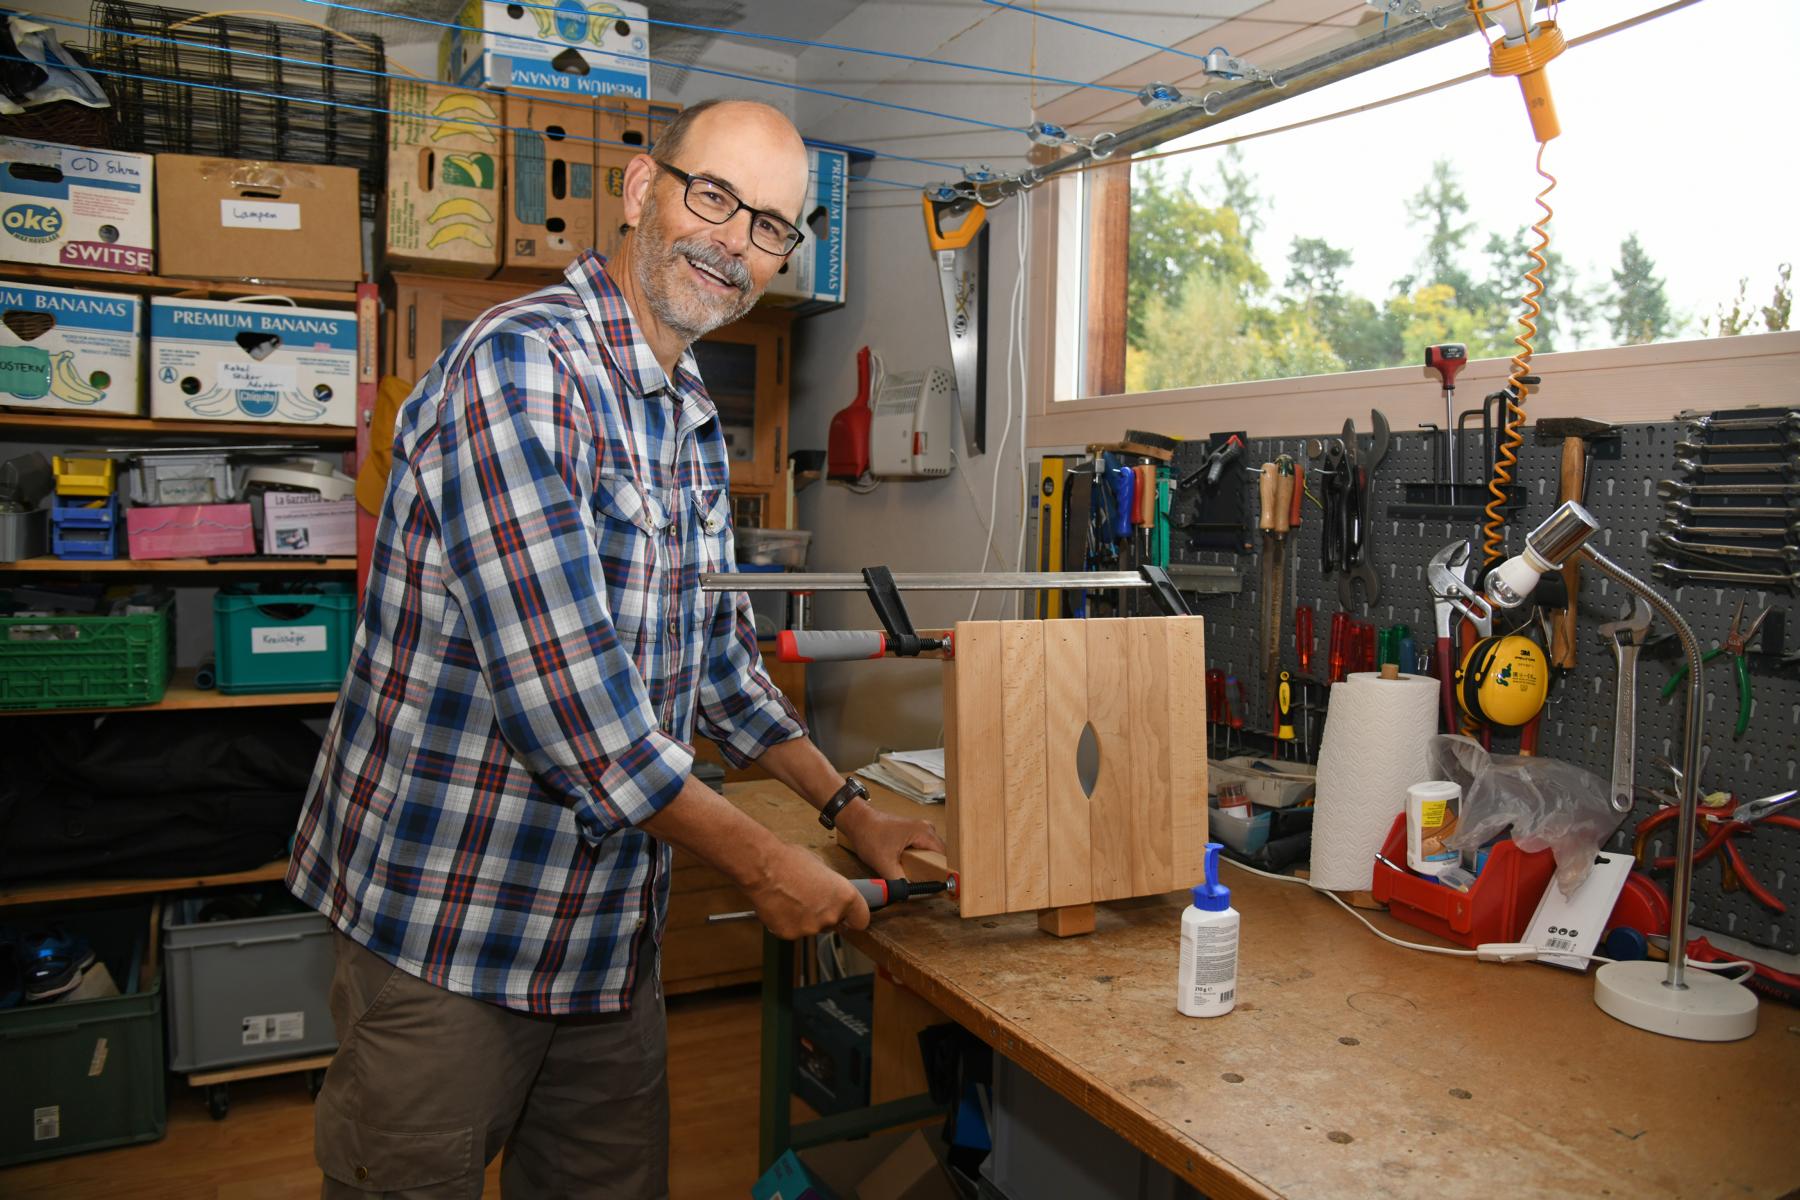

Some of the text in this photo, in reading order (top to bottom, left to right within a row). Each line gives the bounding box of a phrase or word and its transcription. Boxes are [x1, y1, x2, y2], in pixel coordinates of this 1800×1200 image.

[512, 70, 642, 98] PREMIUM BANANA
[71, 157, 99, 172] CD
[5, 207, 59, 232] oké
[232, 207, 278, 222] Lampen
[828, 158, 842, 290] PREMIUM BANANAS
[65, 243, 150, 268] SWITSE
[35, 294, 127, 317] BANANAS
[173, 309, 338, 335] PREMIUM BANANAS
